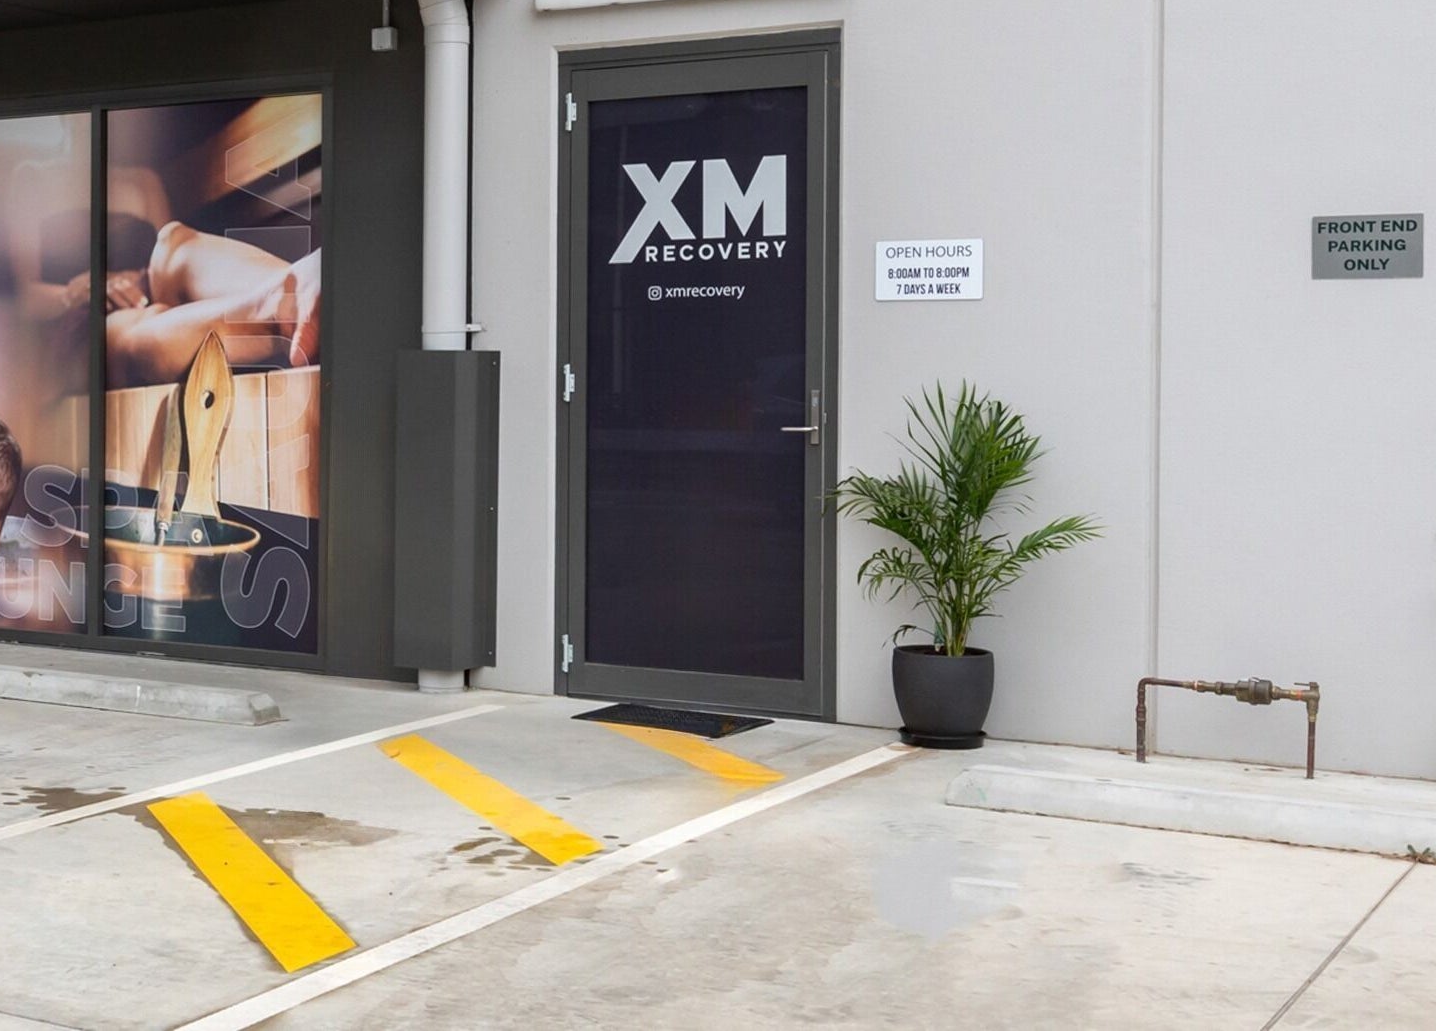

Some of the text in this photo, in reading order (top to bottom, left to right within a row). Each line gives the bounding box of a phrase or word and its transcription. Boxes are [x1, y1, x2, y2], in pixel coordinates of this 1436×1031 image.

[608, 154, 787, 265] XM
[1317, 219, 1418, 234] FRONT END
[645, 240, 787, 263] RECOVERY
[885, 245, 972, 258] OPEN HOURS
[1327, 239, 1406, 252] PARKING
[1344, 258, 1391, 271] ONLY
[887, 266, 970, 280] 8:00AM TO 8:00PM
[665, 285, 745, 300] xmrecovery
[896, 283, 961, 295] 7 DAYS A WEEK
[20, 464, 215, 557] SPA
